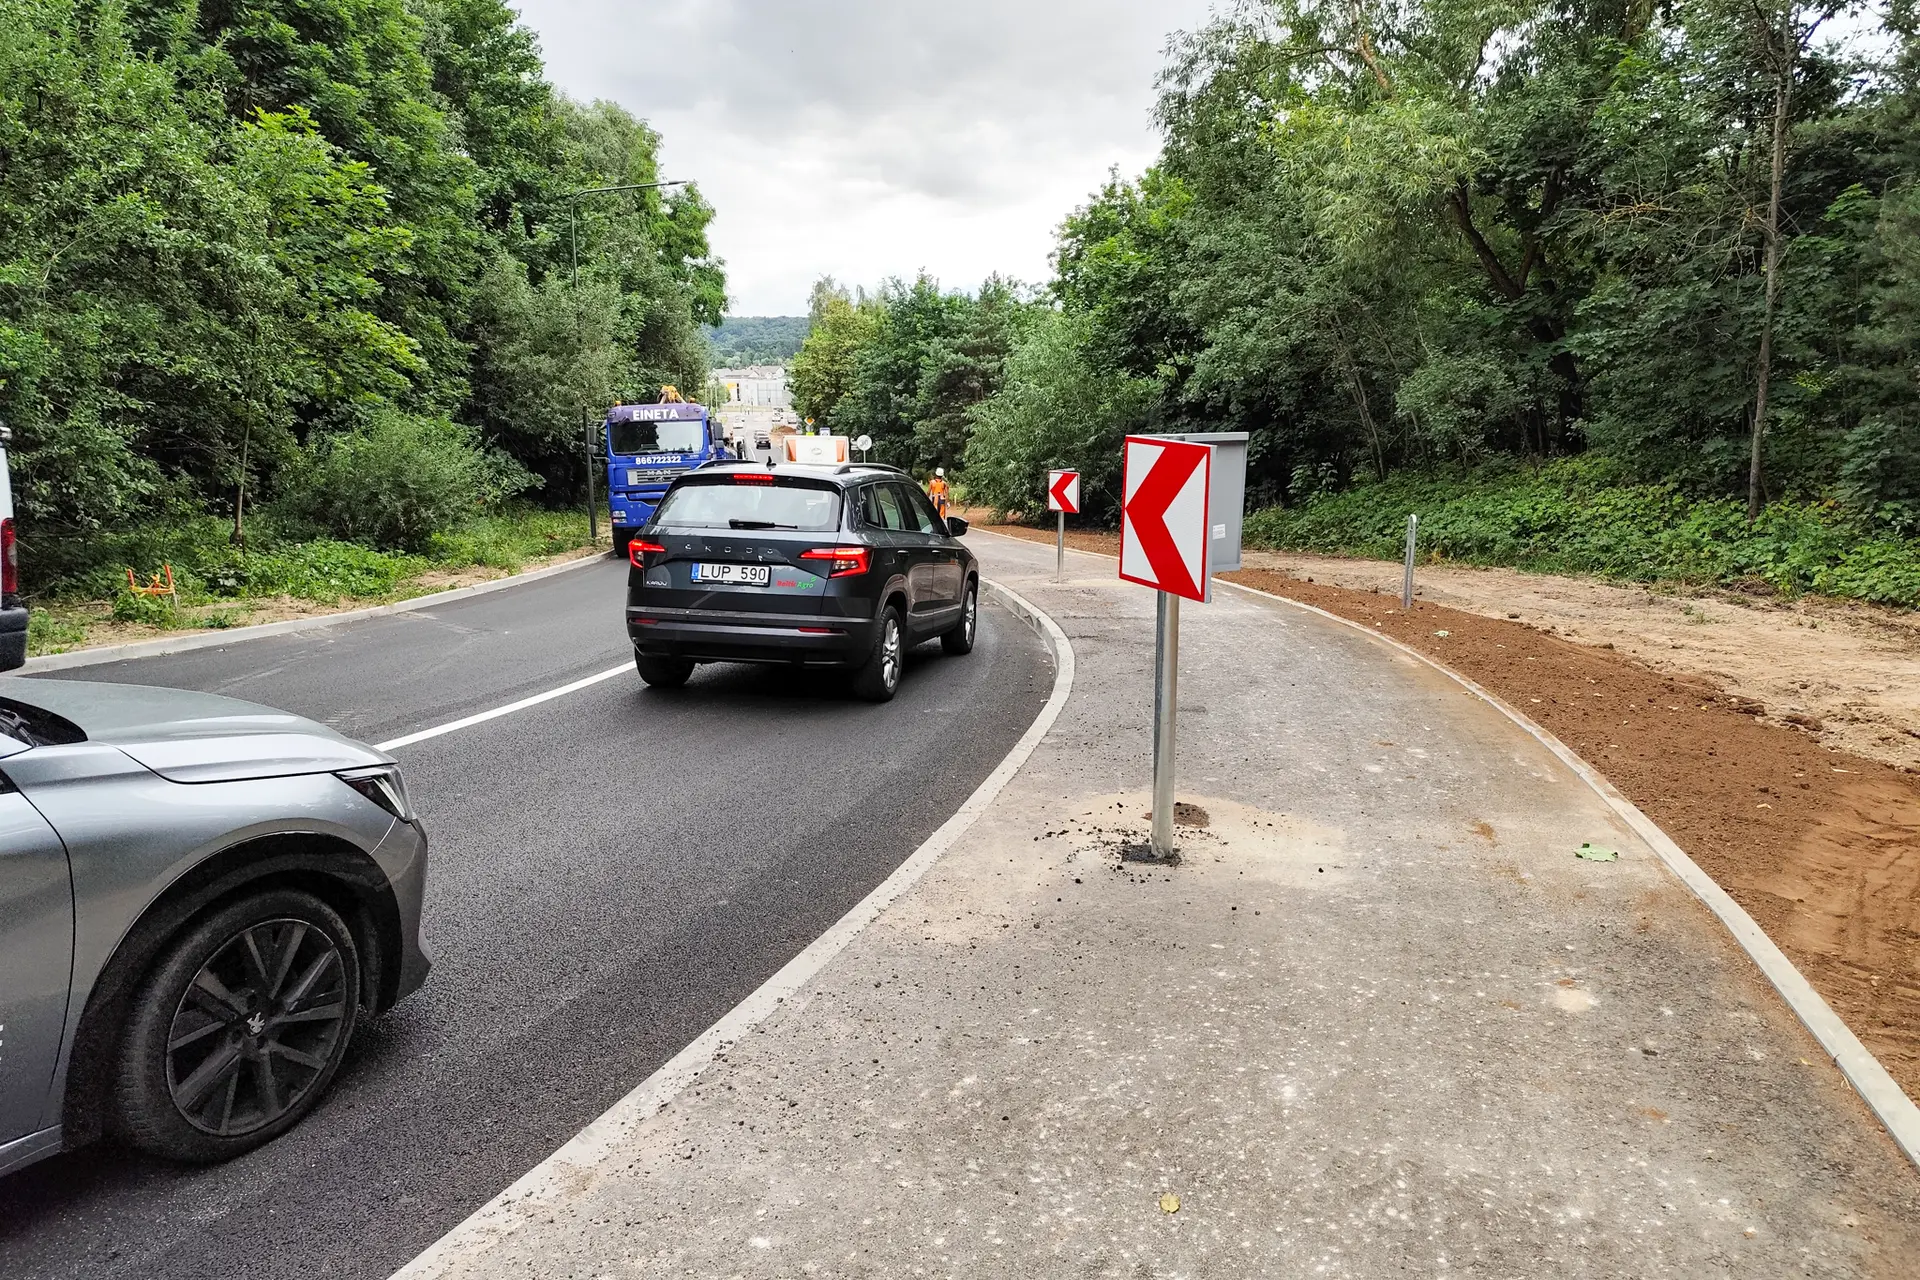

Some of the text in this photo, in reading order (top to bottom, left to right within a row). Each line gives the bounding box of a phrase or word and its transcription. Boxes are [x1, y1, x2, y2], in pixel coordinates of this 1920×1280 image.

[633, 408, 679, 420] EINETA
[636, 456, 681, 465] 866722322
[700, 565, 766, 581] LUP 590
